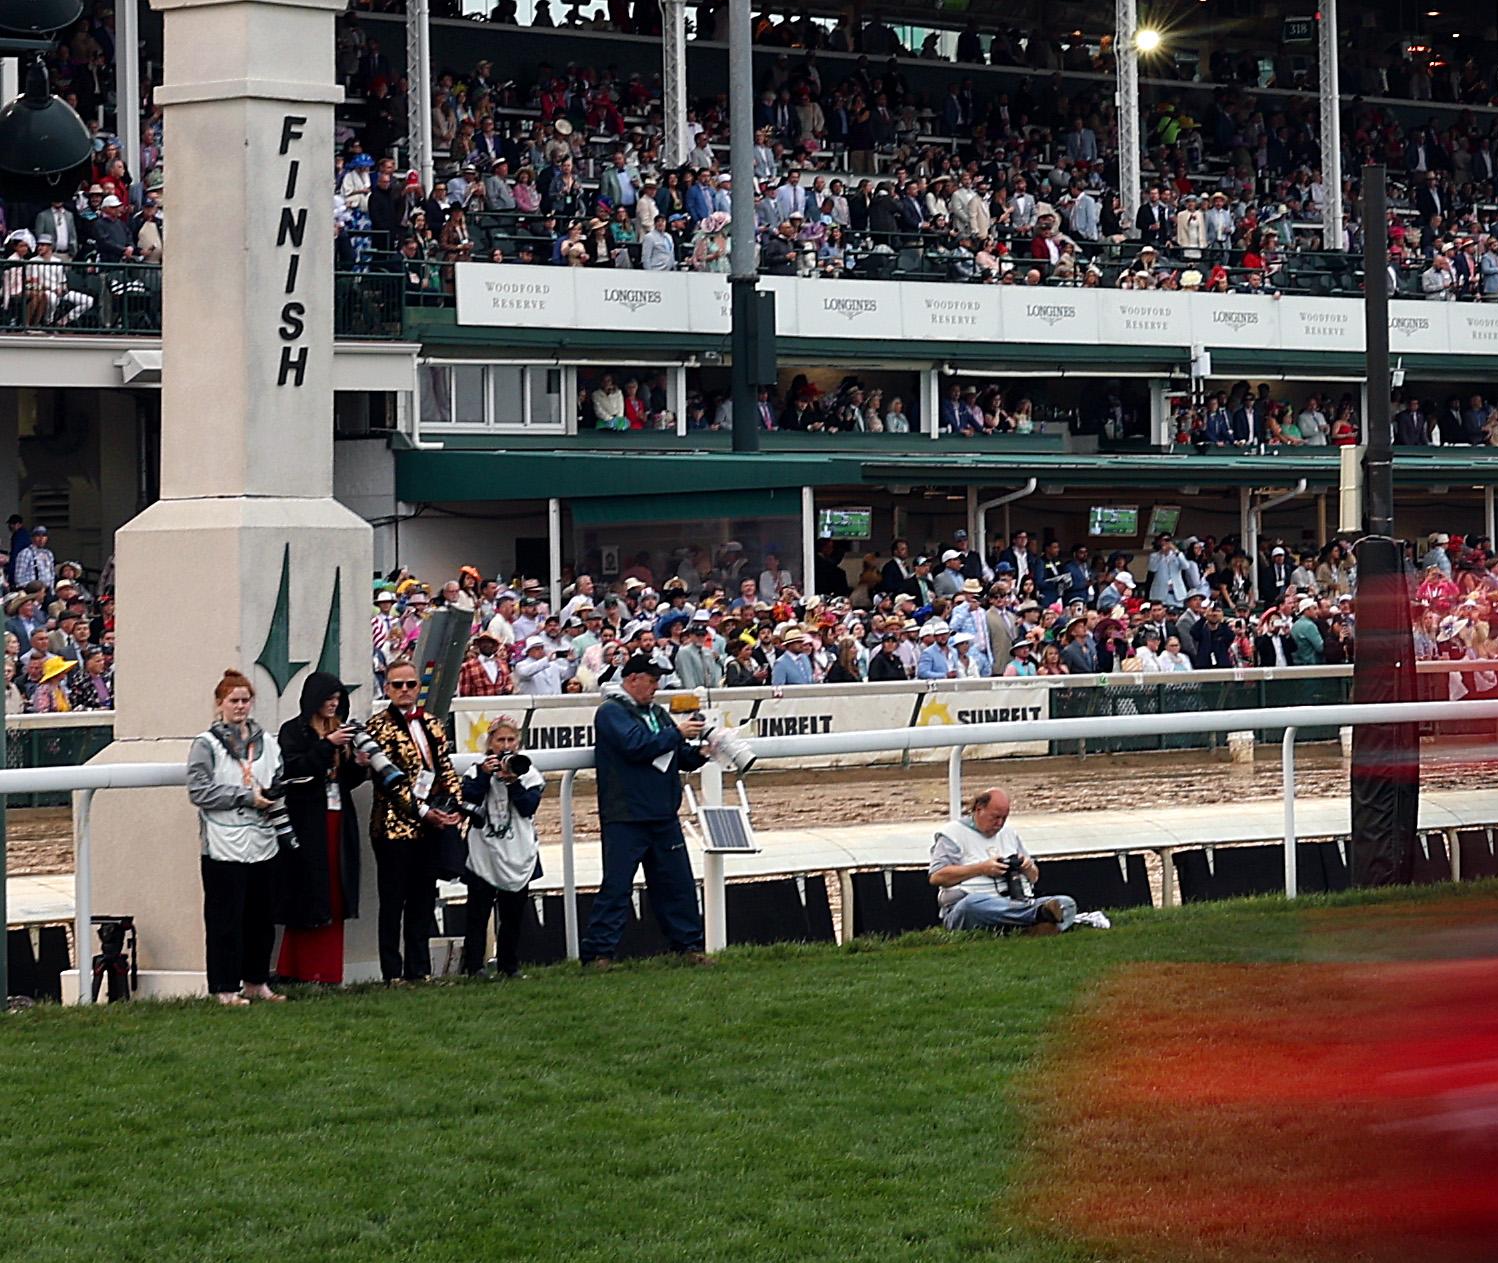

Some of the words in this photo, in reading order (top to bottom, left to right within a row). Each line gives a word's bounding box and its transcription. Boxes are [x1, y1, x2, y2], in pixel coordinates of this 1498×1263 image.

[276, 115, 309, 387] FINISH
[484, 281, 551, 295] WOODFORD
[604, 288, 662, 304] LONGINES
[492, 297, 545, 310] RESERVE
[823, 297, 878, 312] LONGINES
[924, 298, 981, 311] WOODFORD
[1119, 304, 1172, 317] WOODFORD
[1026, 304, 1076, 319] LONGINES
[1212, 310, 1259, 325] LONGINES
[1298, 311, 1349, 323] WOODFORD
[931, 313, 977, 325] RESERVE
[1125, 319, 1168, 331] RESERVE
[1304, 325, 1345, 337] RESERVE
[957, 705, 1042, 725] SUNBELT
[739, 715, 833, 737] UNBELT
[524, 725, 596, 750] UNBEL
